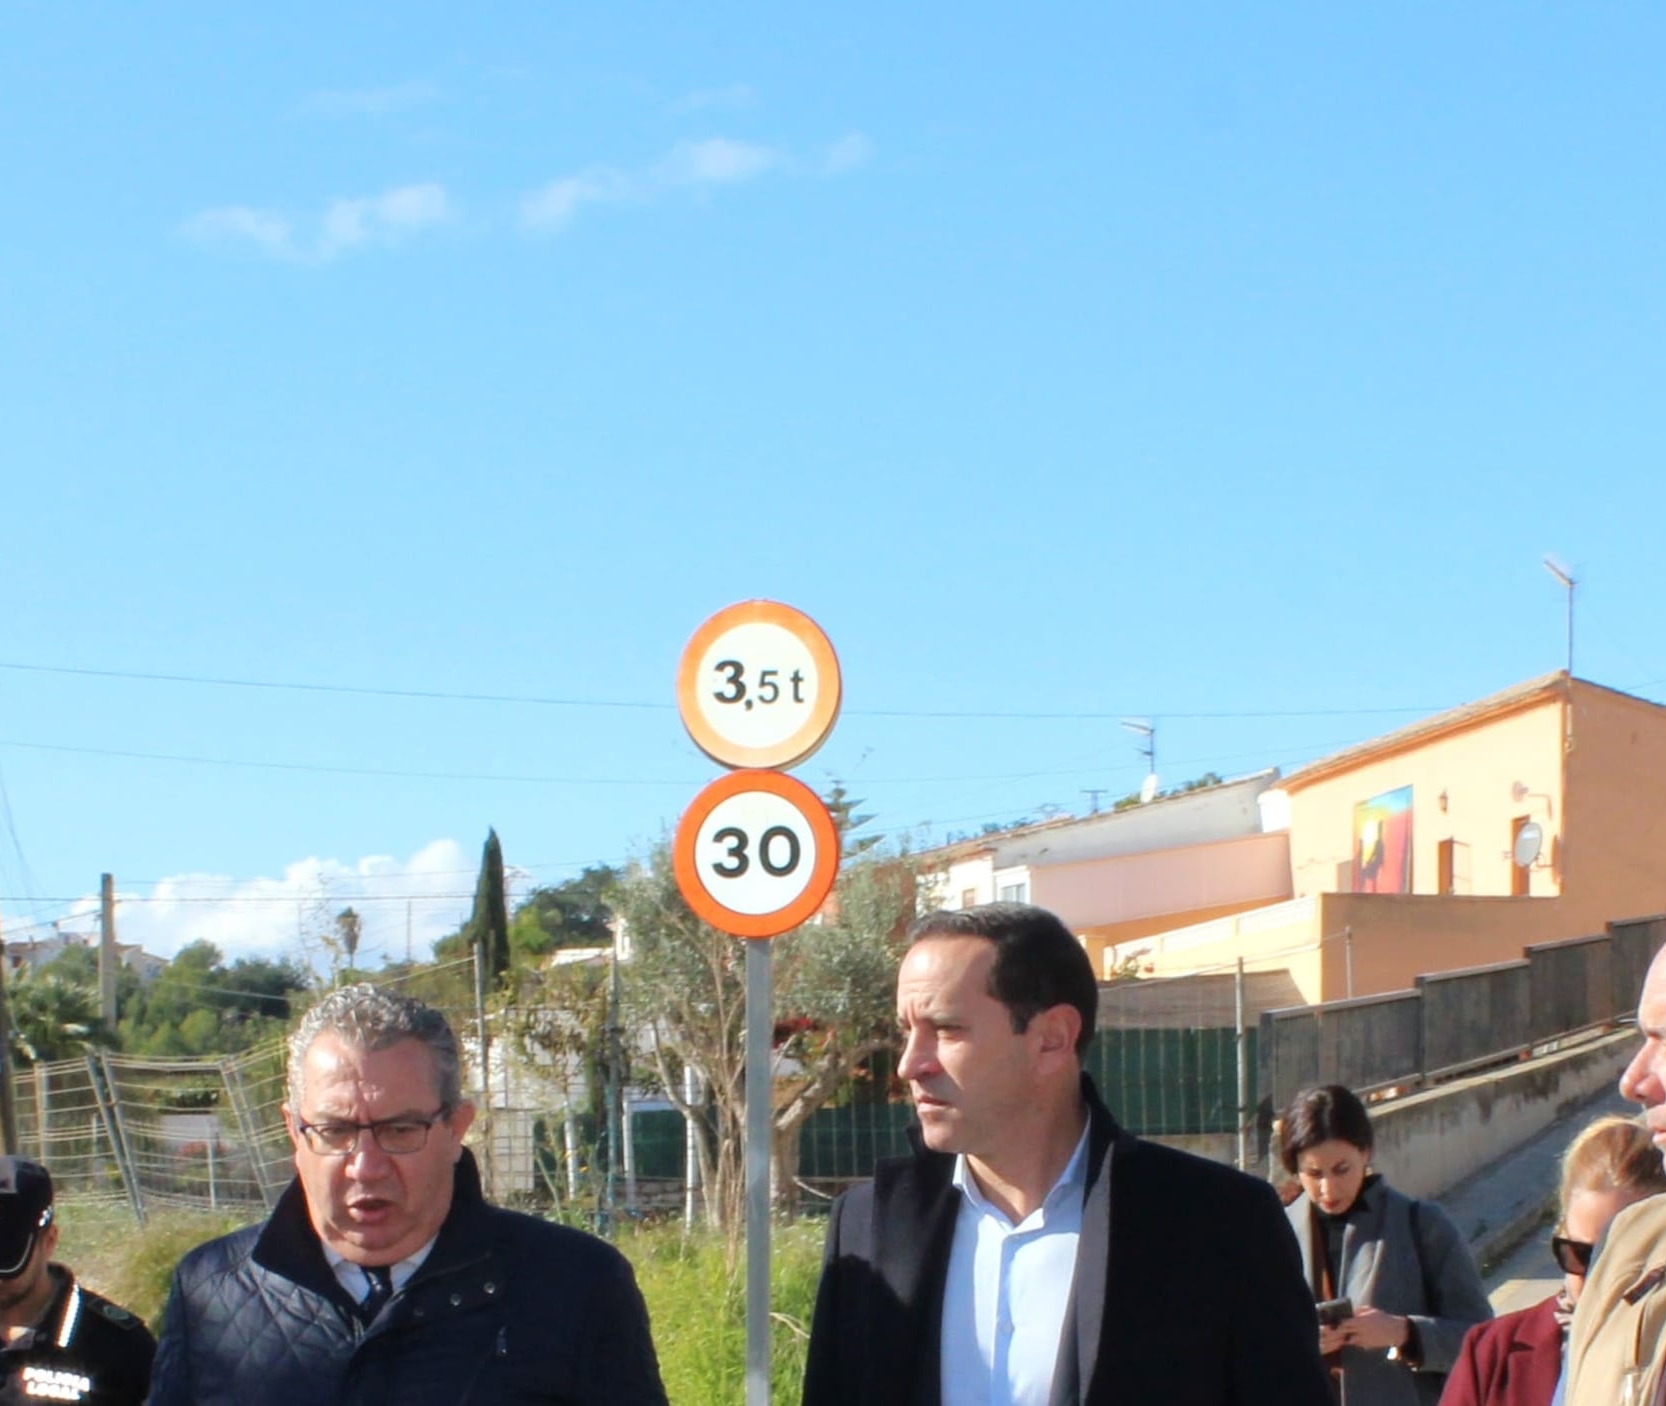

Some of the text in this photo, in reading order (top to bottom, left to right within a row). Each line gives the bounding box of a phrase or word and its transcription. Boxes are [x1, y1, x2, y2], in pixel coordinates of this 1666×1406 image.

[712, 659, 805, 711] 3,5 t
[711, 825, 801, 880] 30
[25, 1381, 82, 1400] LOCAL
